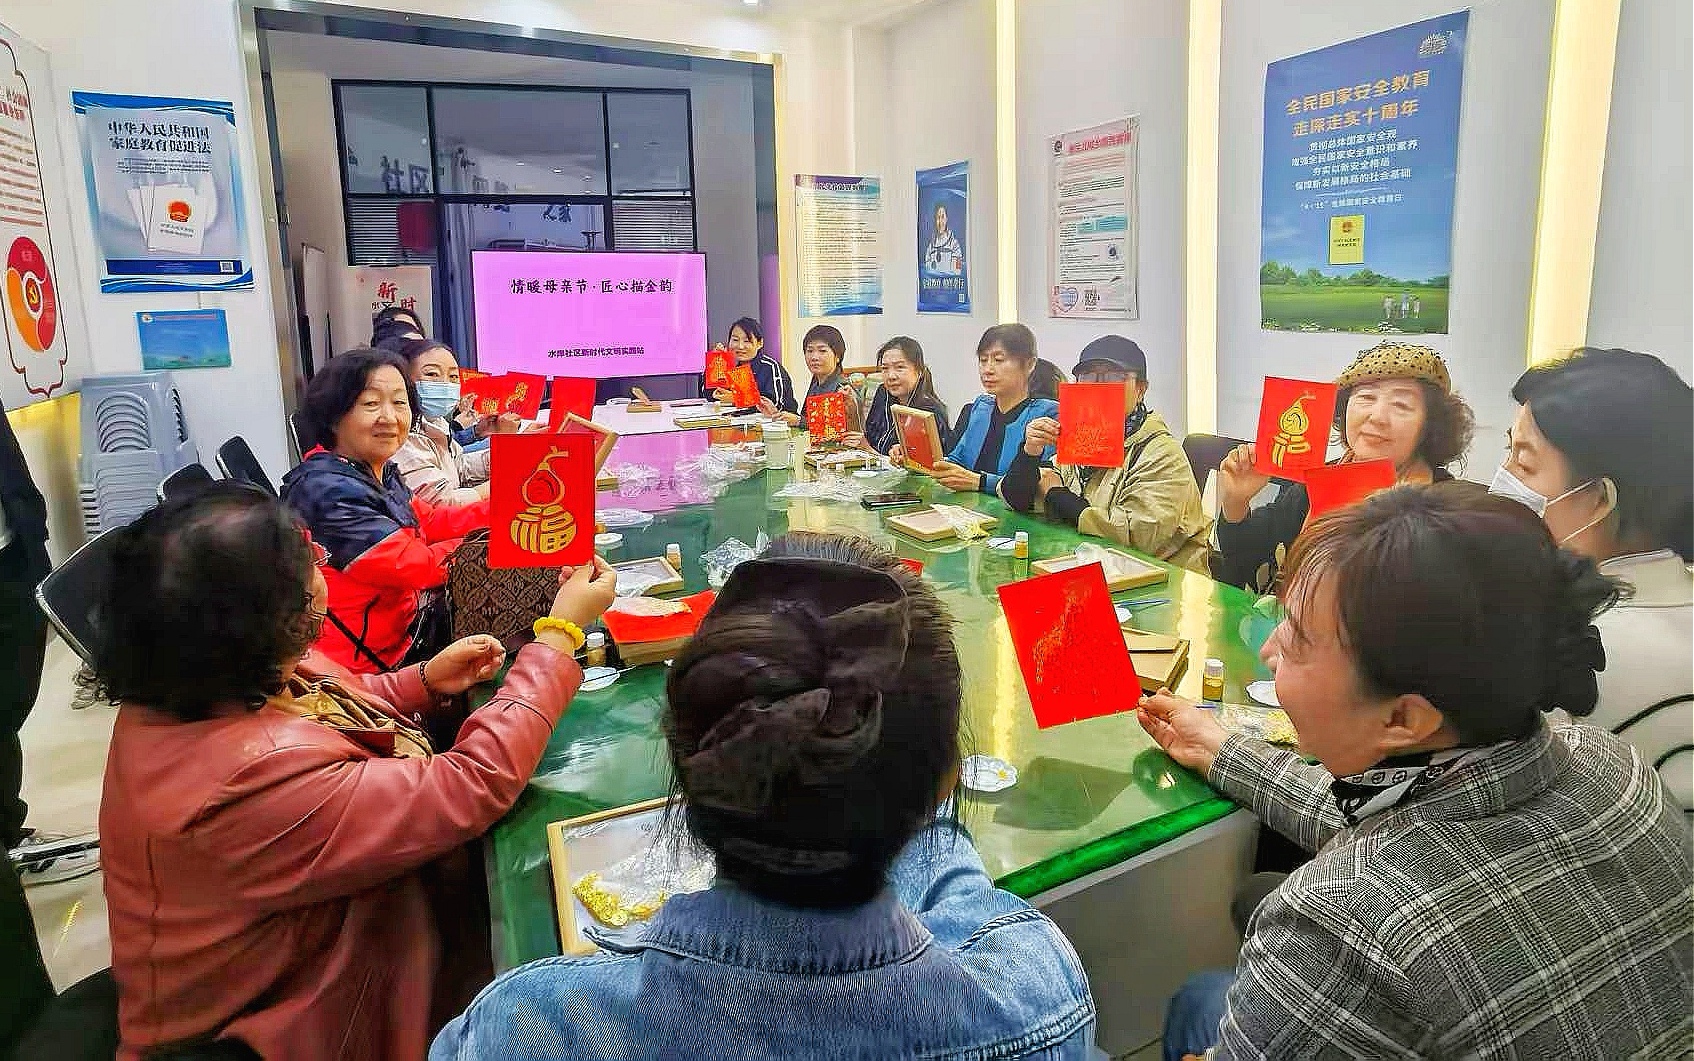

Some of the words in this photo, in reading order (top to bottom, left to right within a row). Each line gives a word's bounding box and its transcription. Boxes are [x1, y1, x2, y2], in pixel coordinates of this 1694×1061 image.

[1285, 70, 1430, 115] 全民国家安全教育
[1292, 99, 1420, 137] 走深走实十周年
[108, 120, 210, 140] 中华人民共和国
[109, 137, 212, 153] 家庭教育促进法
[511, 279, 672, 294] 情暖母亲节·匠心描金韵
